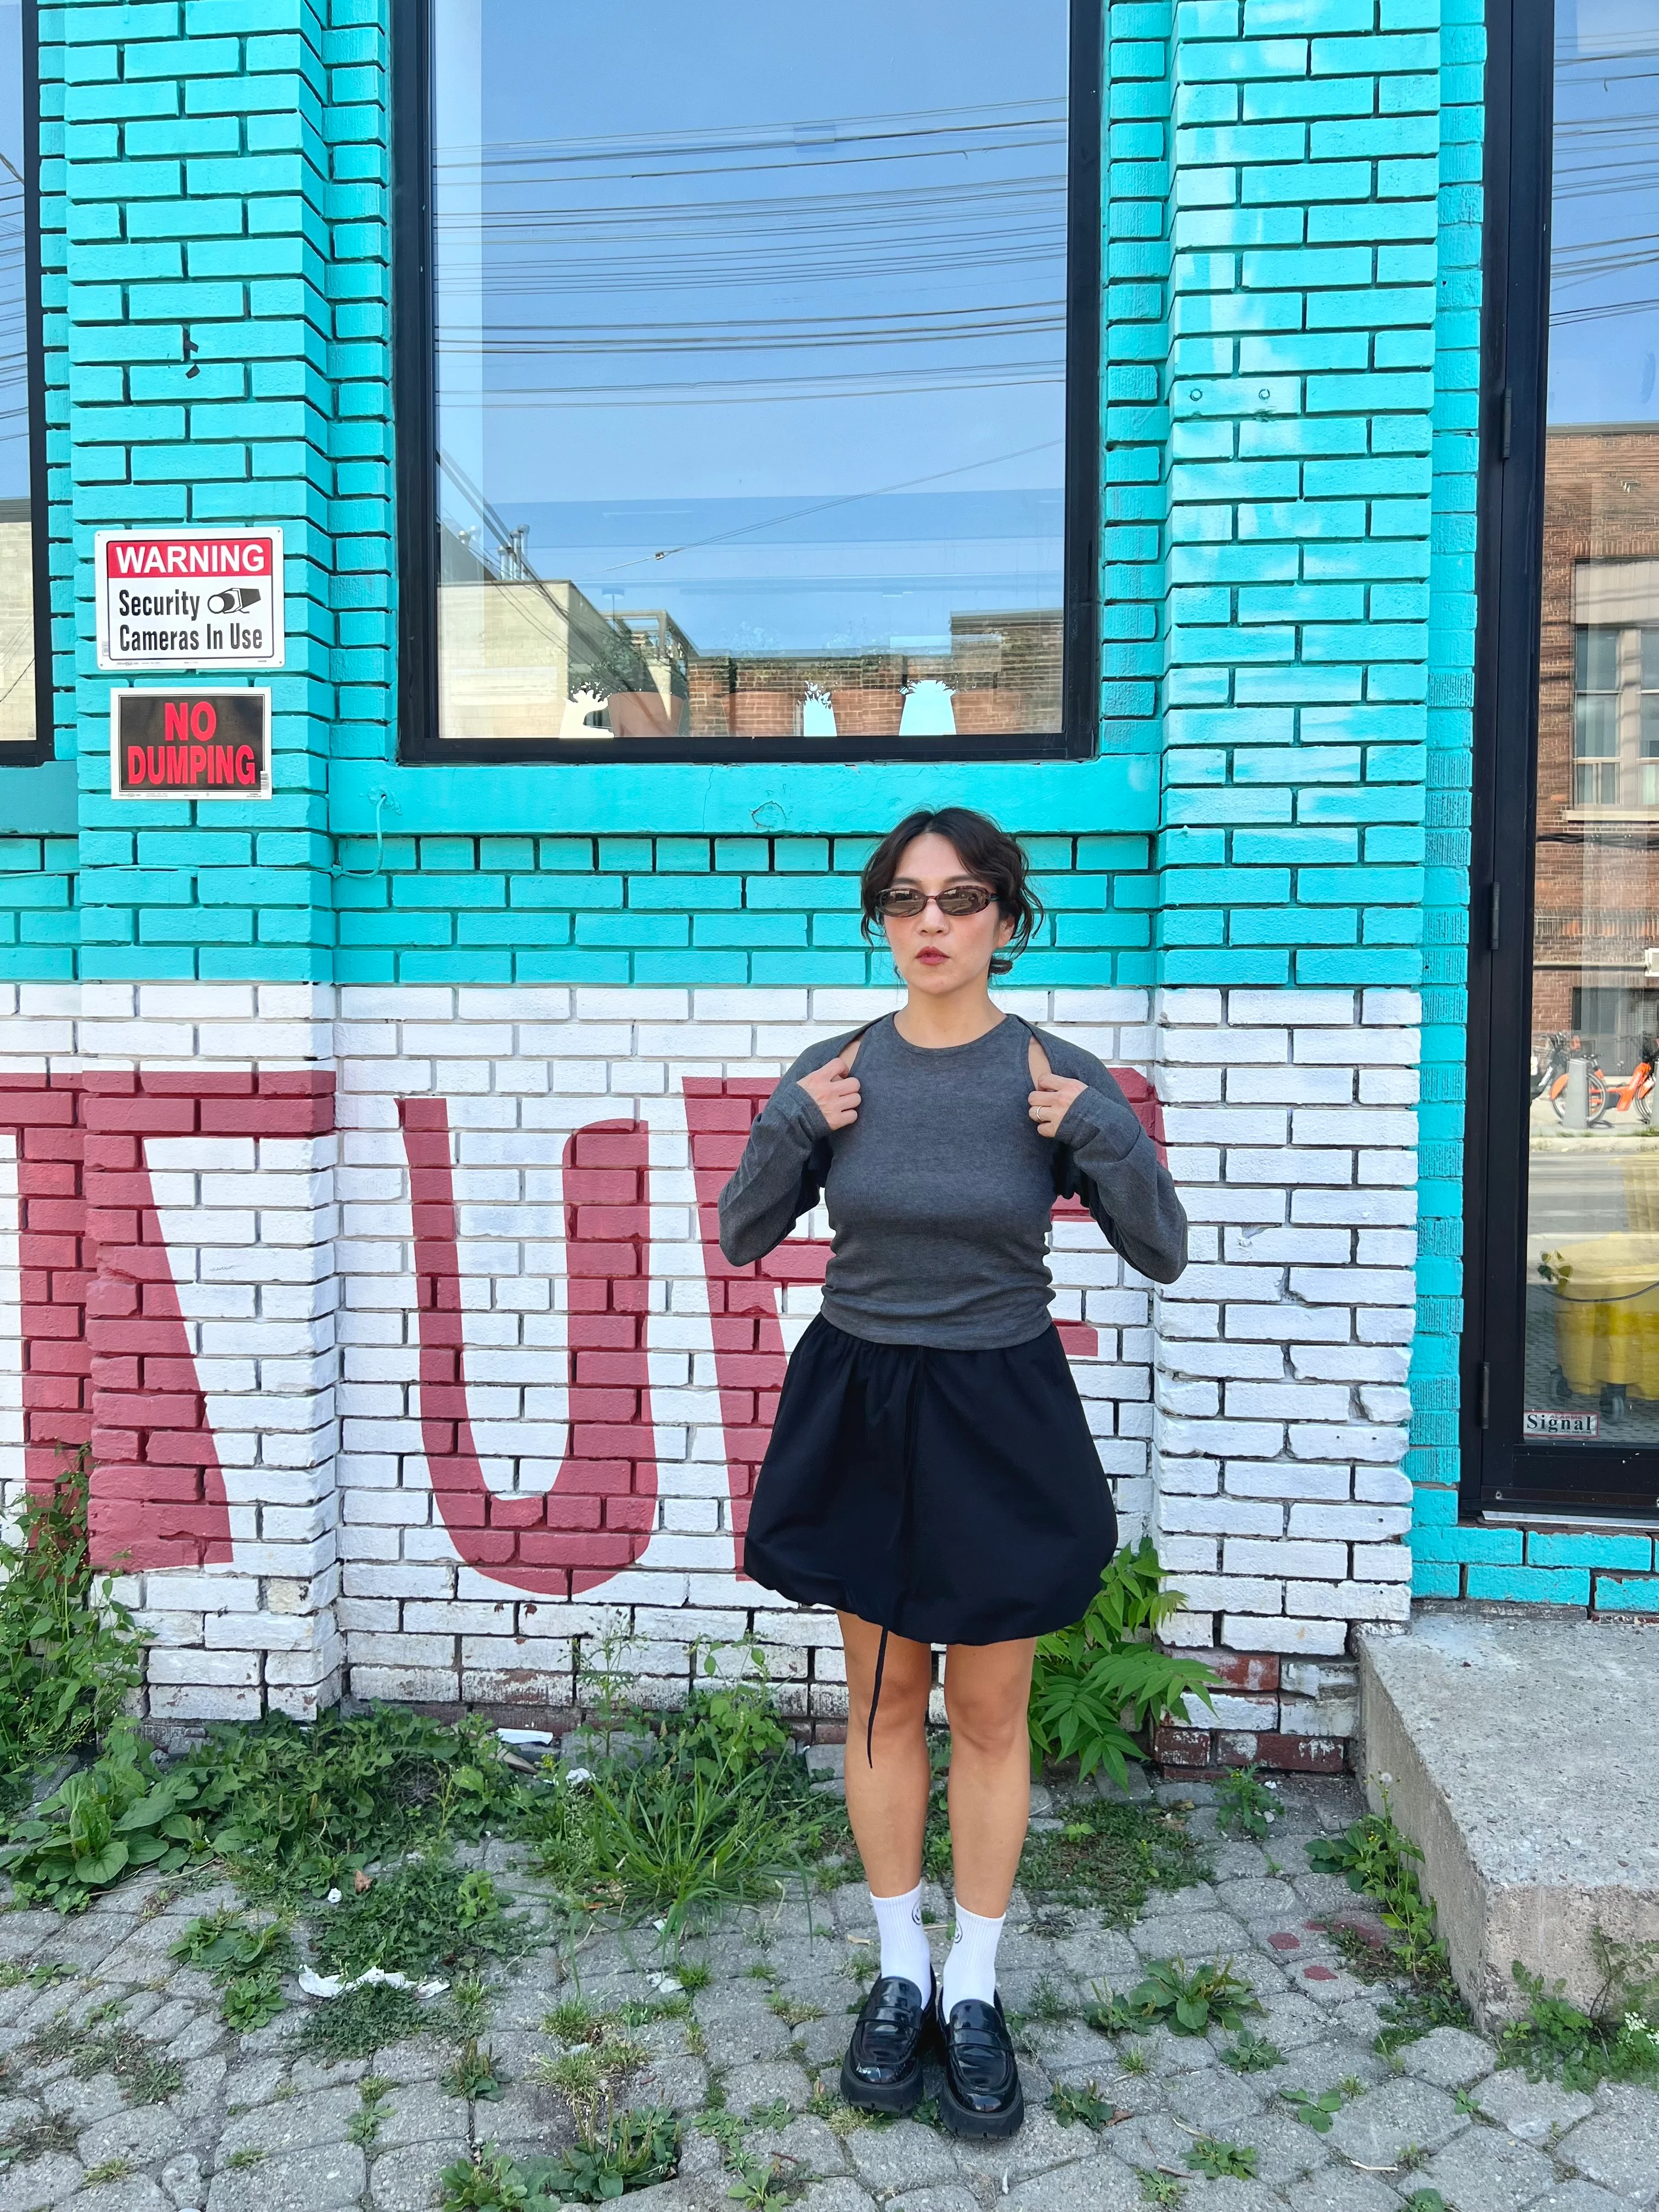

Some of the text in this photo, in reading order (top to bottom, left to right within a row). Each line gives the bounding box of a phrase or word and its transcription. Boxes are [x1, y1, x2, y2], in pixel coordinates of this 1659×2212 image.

[116, 544, 264, 574] WARNING
[119, 589, 200, 621] Security
[120, 622, 263, 651] Cameras In Use
[165, 701, 216, 742] NO
[128, 744, 256, 785] DUMPING
[1527, 1414, 1591, 1433] Signal
